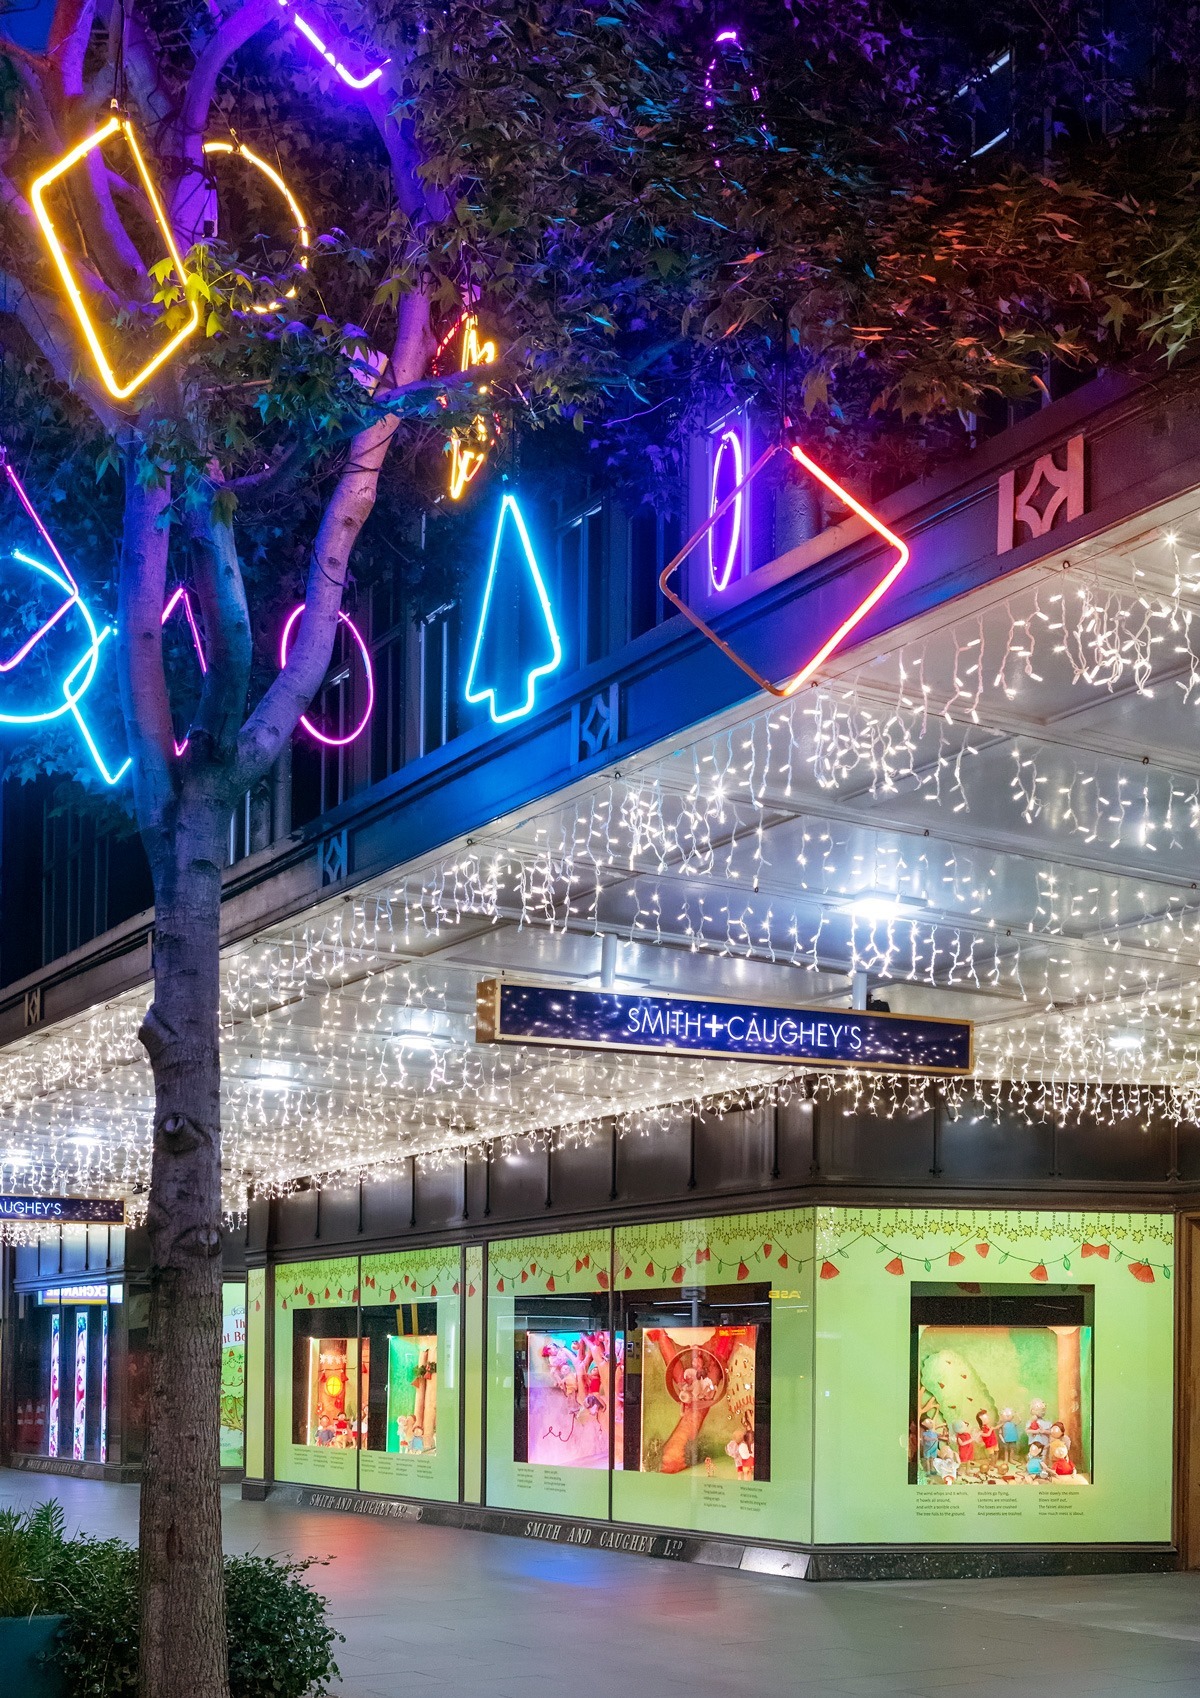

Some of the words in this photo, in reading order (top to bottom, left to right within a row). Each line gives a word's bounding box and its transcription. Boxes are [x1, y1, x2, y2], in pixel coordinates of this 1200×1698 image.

[309, 1493, 335, 1509] SMITH
[335, 1497, 352, 1511] AND
[353, 1500, 393, 1516] CAUGHEY
[524, 1521, 562, 1541] SMITH
[566, 1527, 592, 1545] AND
[599, 1531, 657, 1553] CAUGHEY
